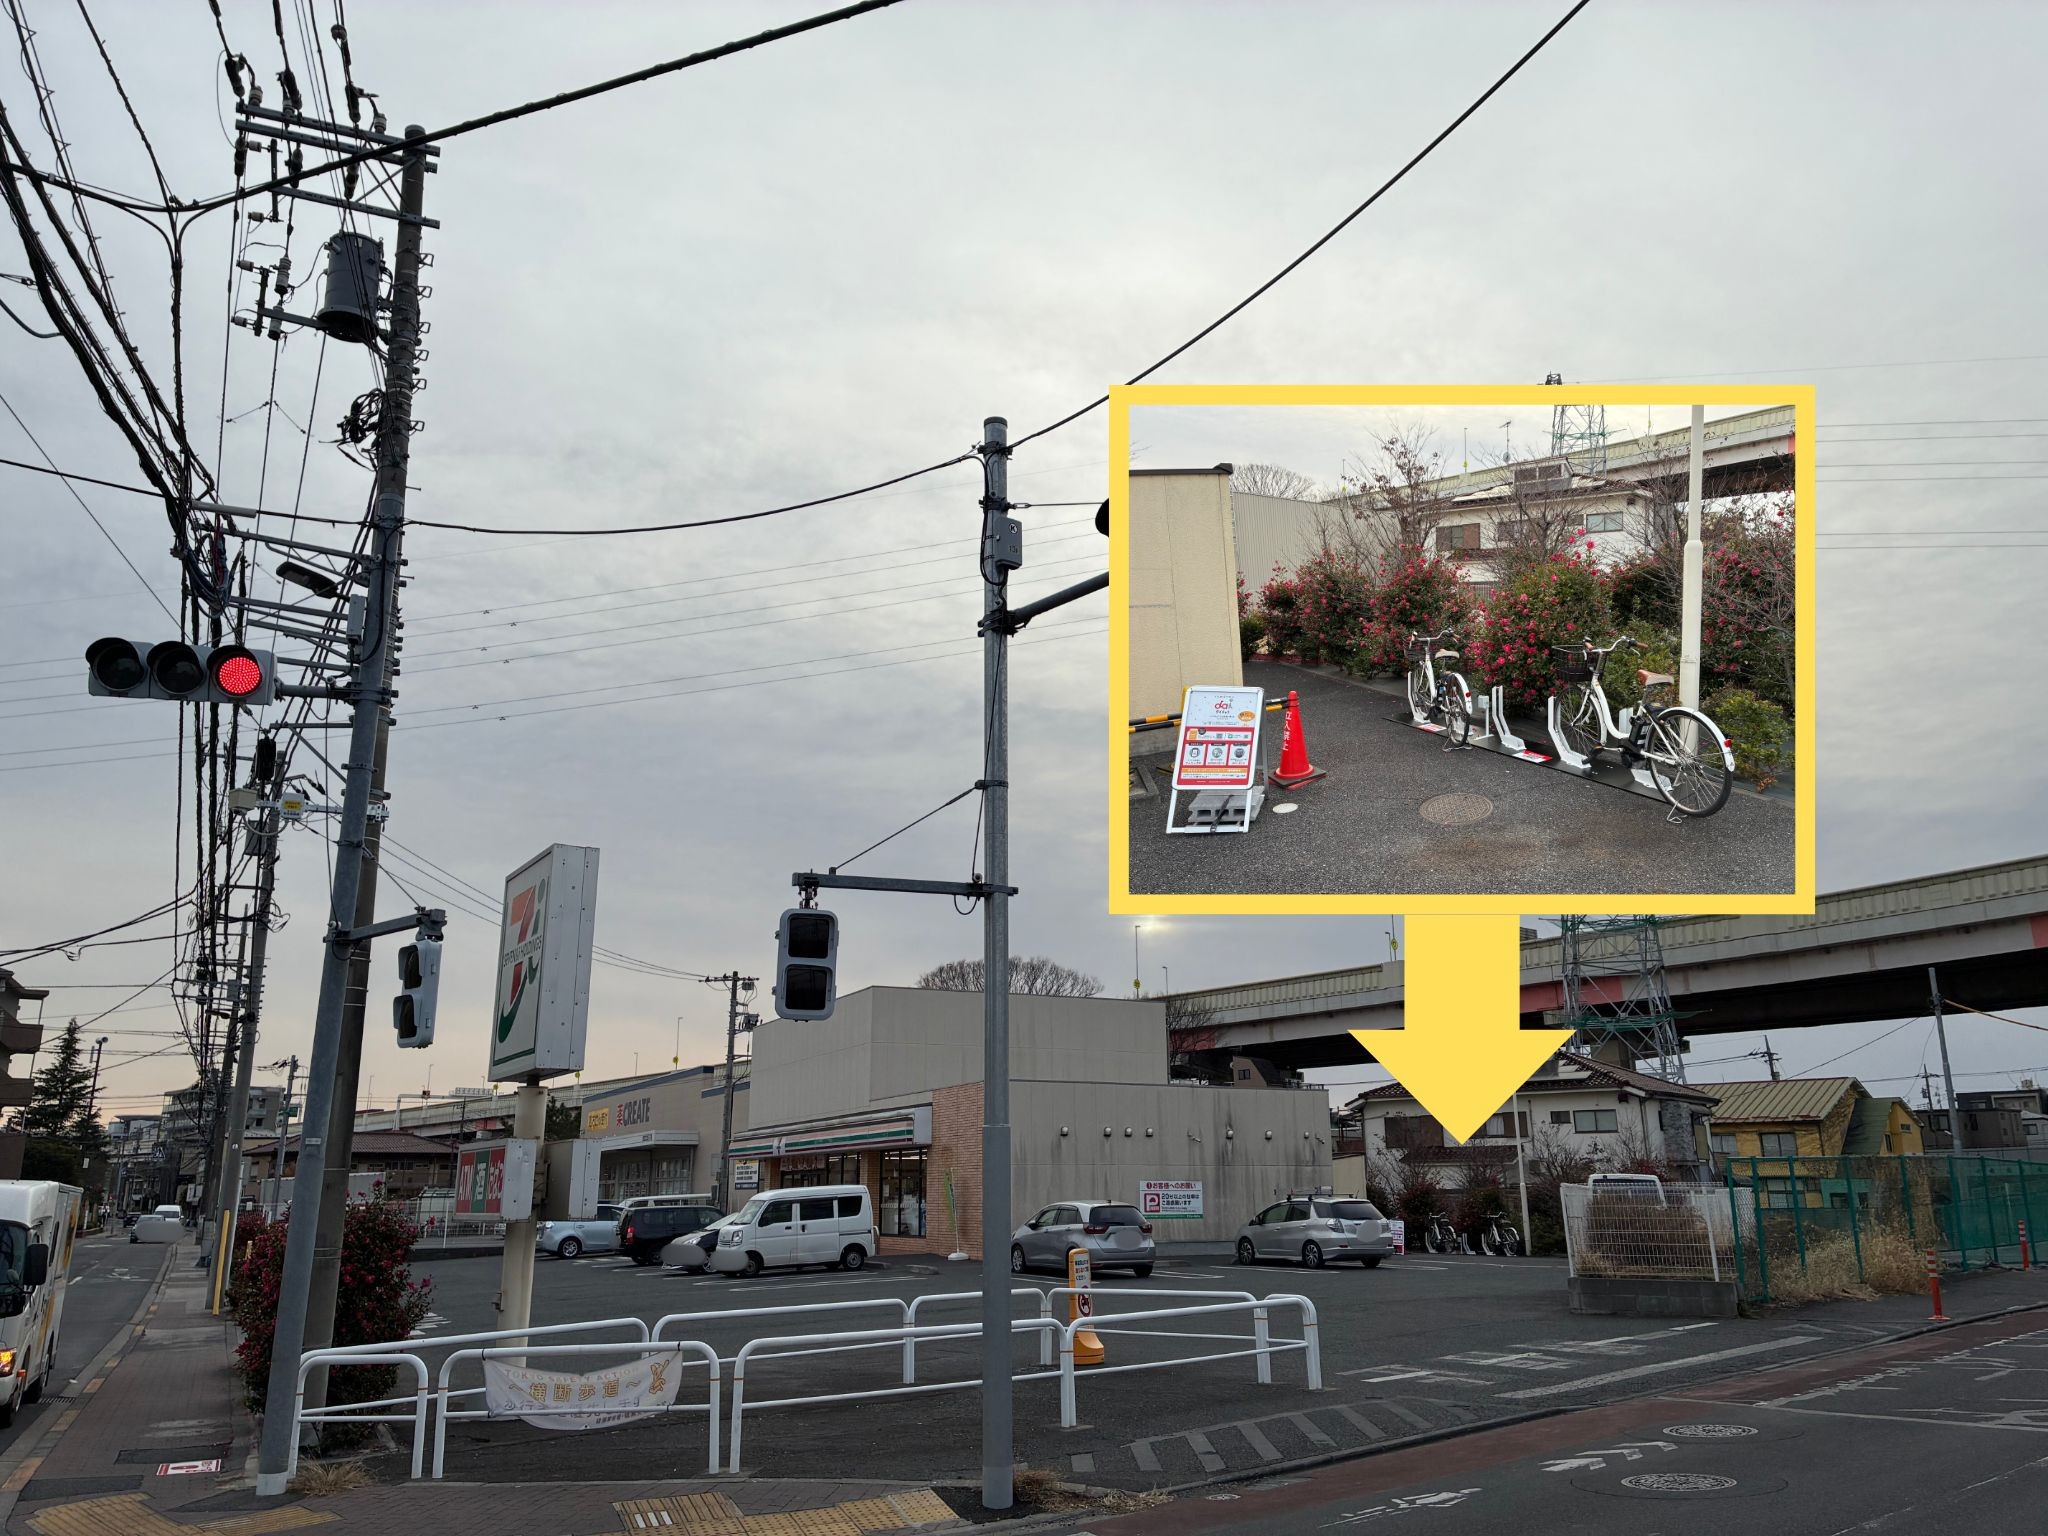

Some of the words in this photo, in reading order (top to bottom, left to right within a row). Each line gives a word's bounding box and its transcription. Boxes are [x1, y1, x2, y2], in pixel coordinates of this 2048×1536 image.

[1282, 711, 1292, 751] 立入禁止
[623, 1096, 651, 1127] CREATE
[458, 1164, 474, 1200] ATM
[476, 1162, 487, 1200] 酒
